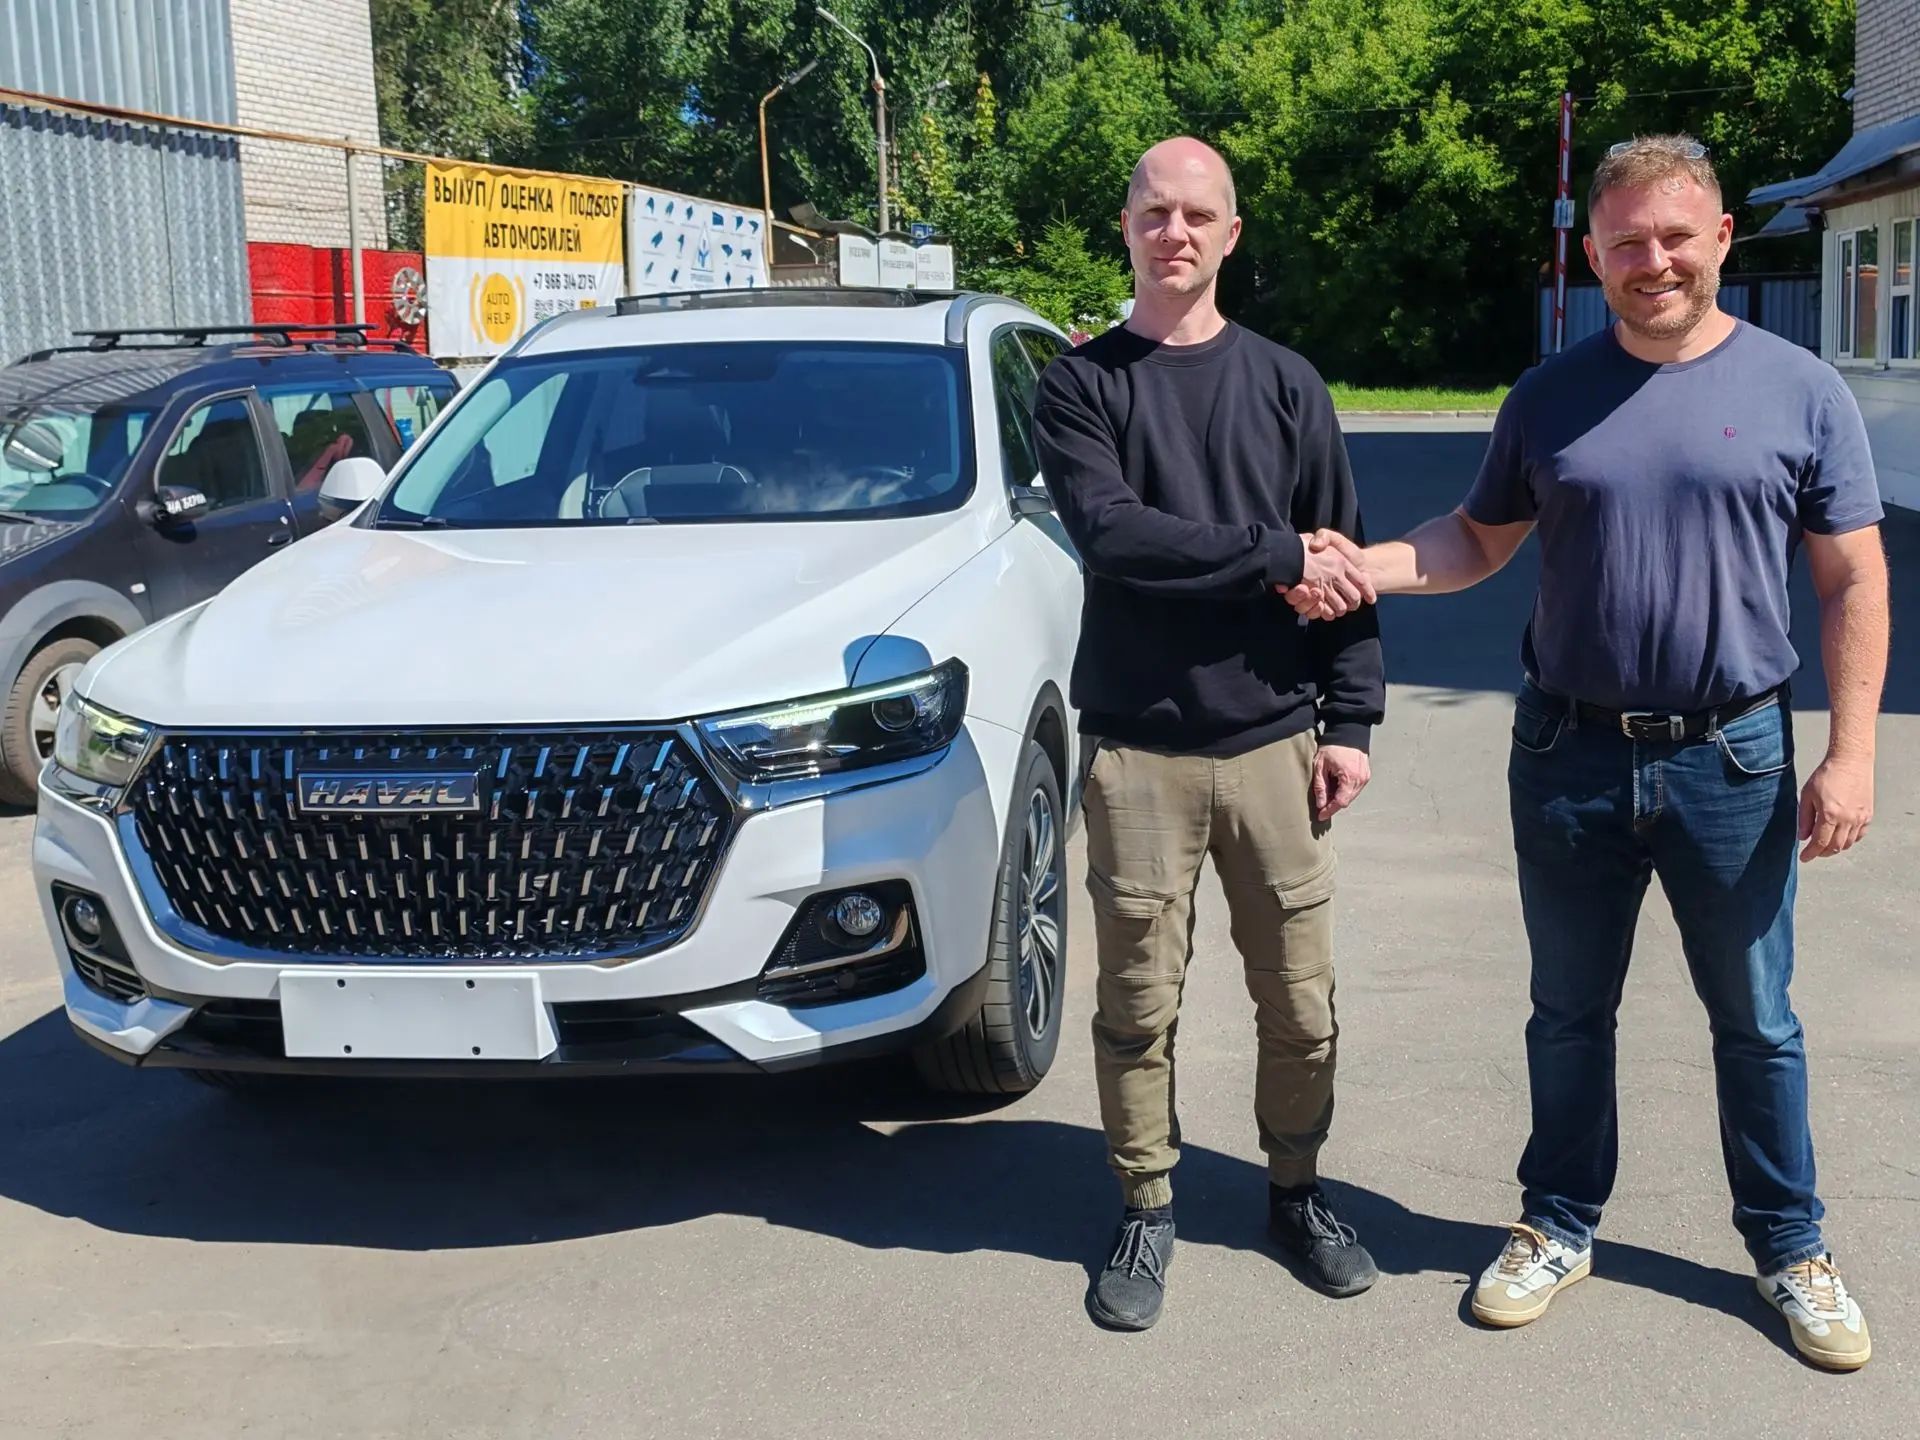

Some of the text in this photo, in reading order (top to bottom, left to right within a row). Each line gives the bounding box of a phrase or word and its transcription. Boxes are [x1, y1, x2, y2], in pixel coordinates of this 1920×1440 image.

[501, 183, 554, 214] ОЦЕНКА
[570, 192, 619, 220] ПОДБОР
[484, 222, 582, 253] АВТОМОБИЛЕЙ
[487, 293, 510, 305] AUTO
[487, 312, 511, 325] HELP
[308, 780, 466, 805] HAVAL
